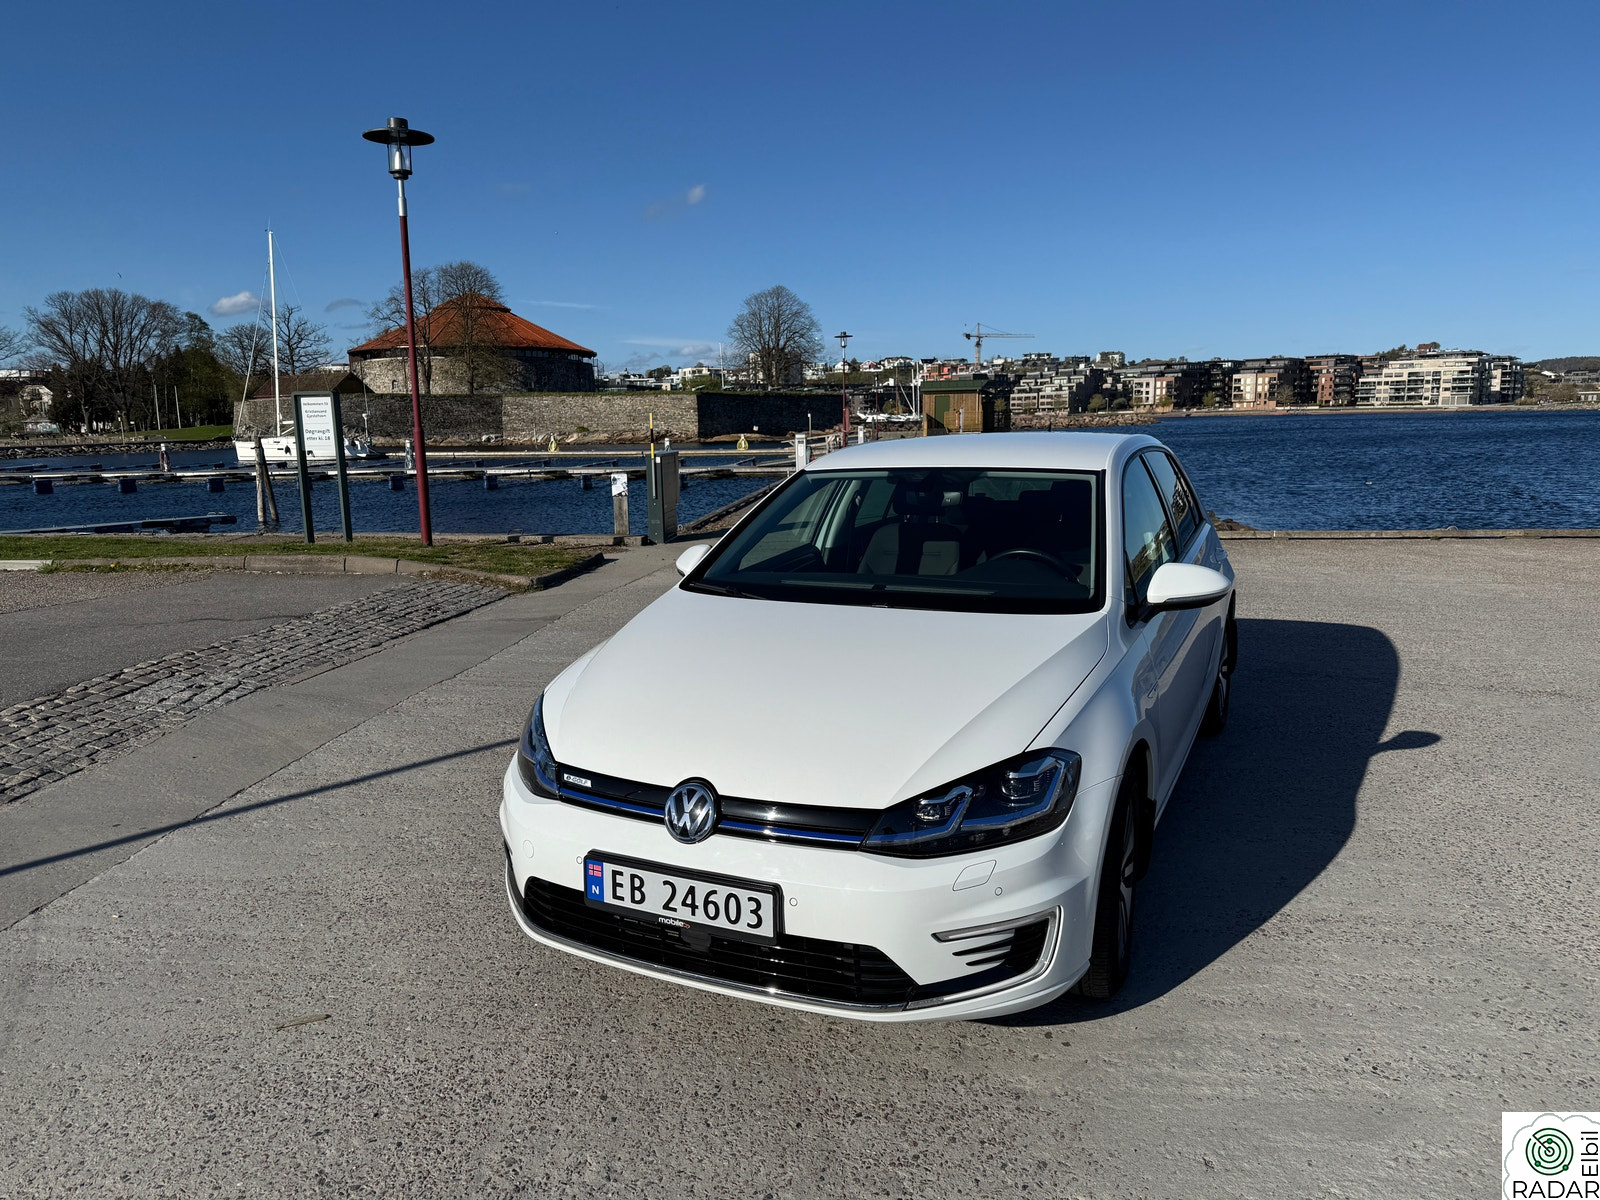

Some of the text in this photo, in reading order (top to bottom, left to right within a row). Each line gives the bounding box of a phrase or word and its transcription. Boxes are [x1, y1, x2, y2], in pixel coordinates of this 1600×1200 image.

[591, 885, 600, 894] N
[611, 869, 763, 930] EB 24603
